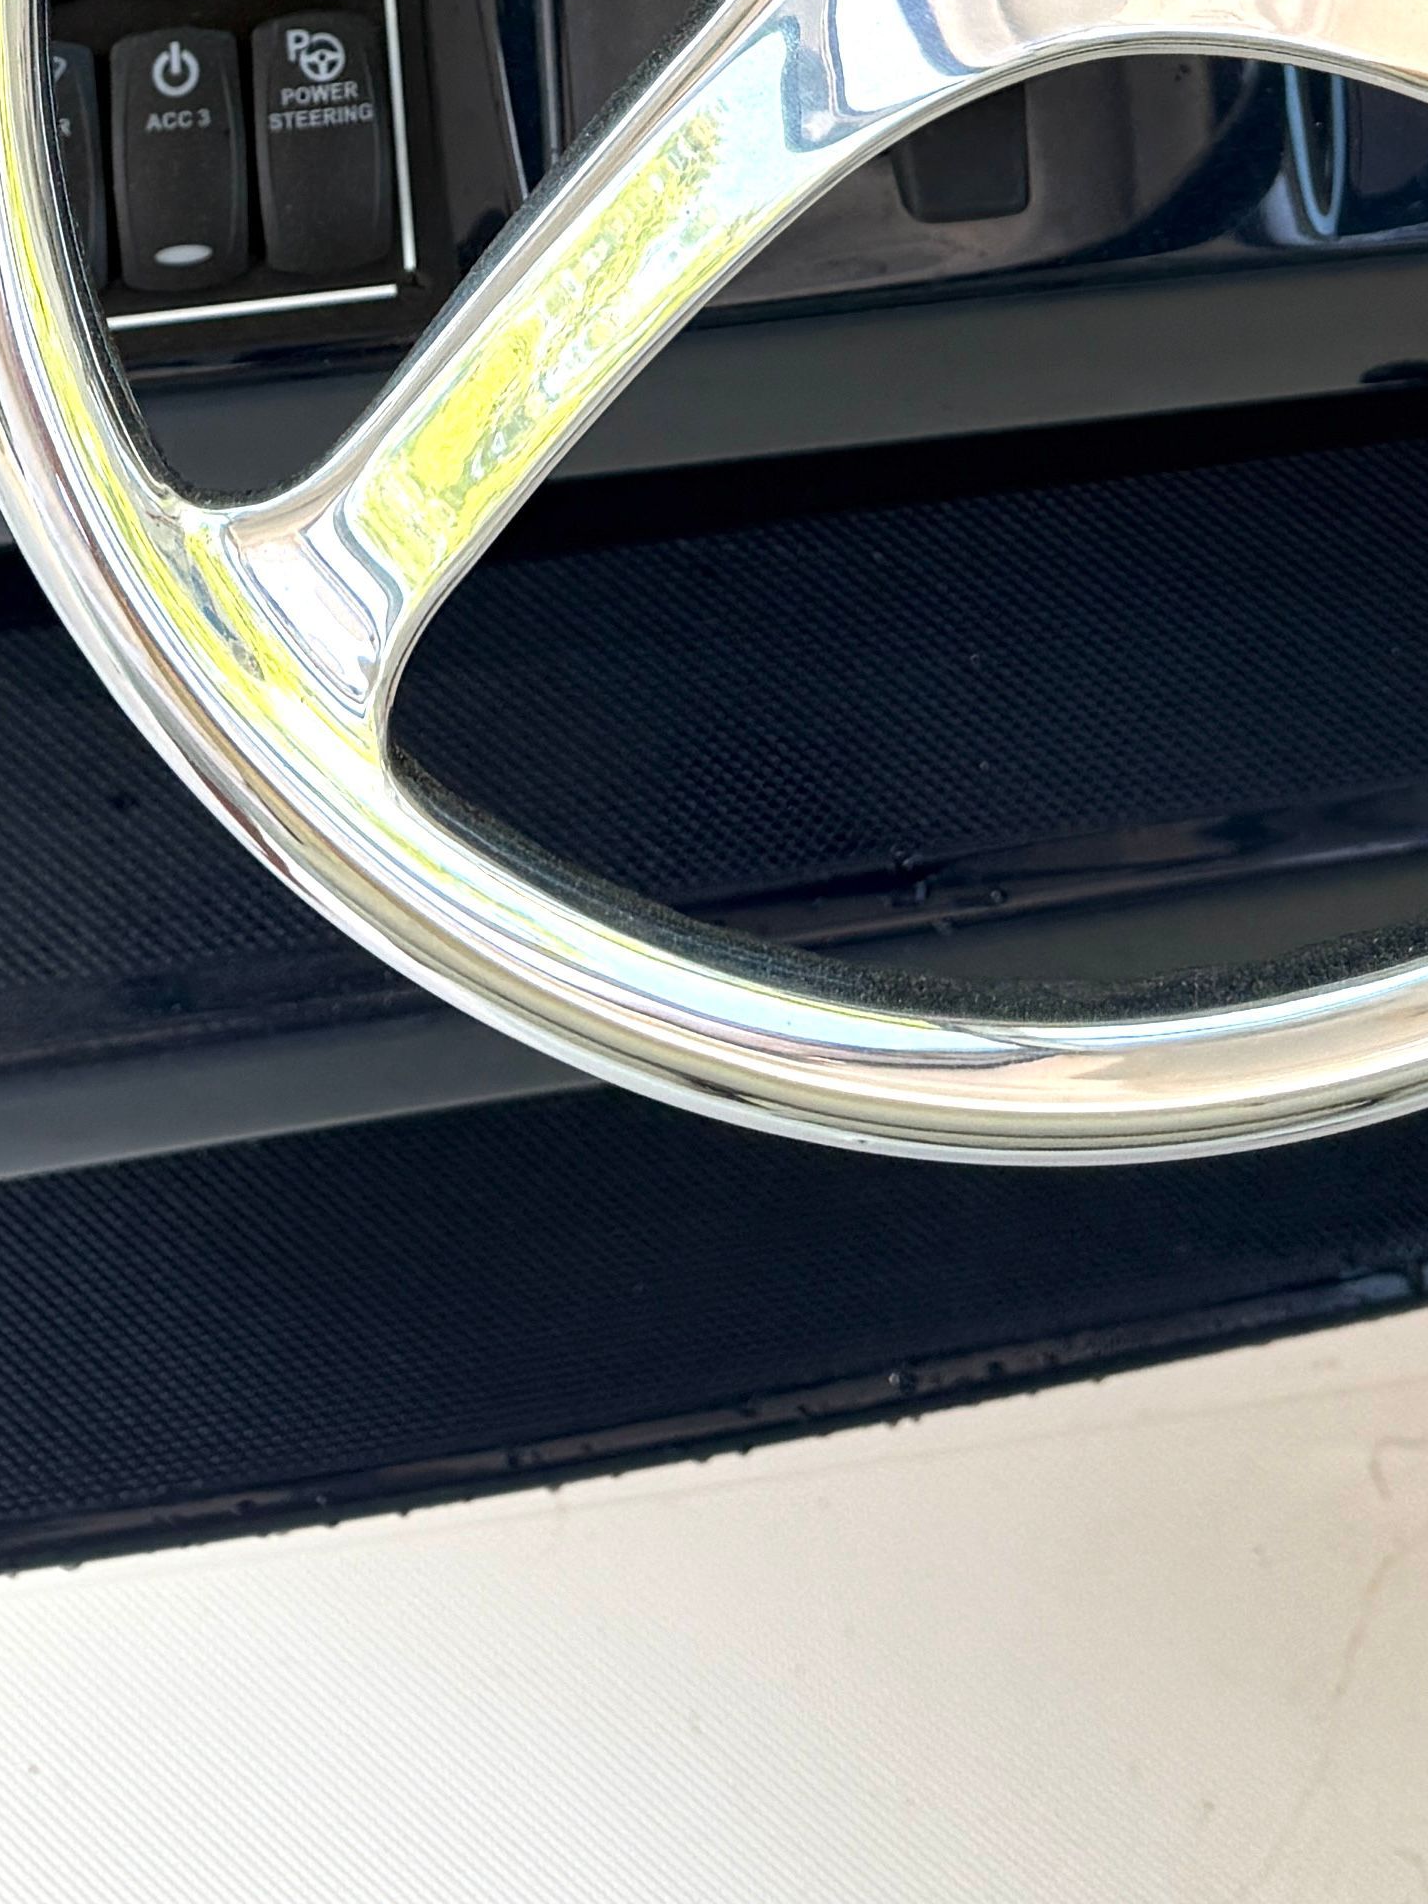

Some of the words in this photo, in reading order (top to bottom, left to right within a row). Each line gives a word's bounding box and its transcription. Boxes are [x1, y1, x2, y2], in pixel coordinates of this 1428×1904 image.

[280, 80, 360, 107] POWER
[144, 109, 194, 133] ACC
[196, 107, 212, 128] 3
[268, 102, 375, 131] STEERING
